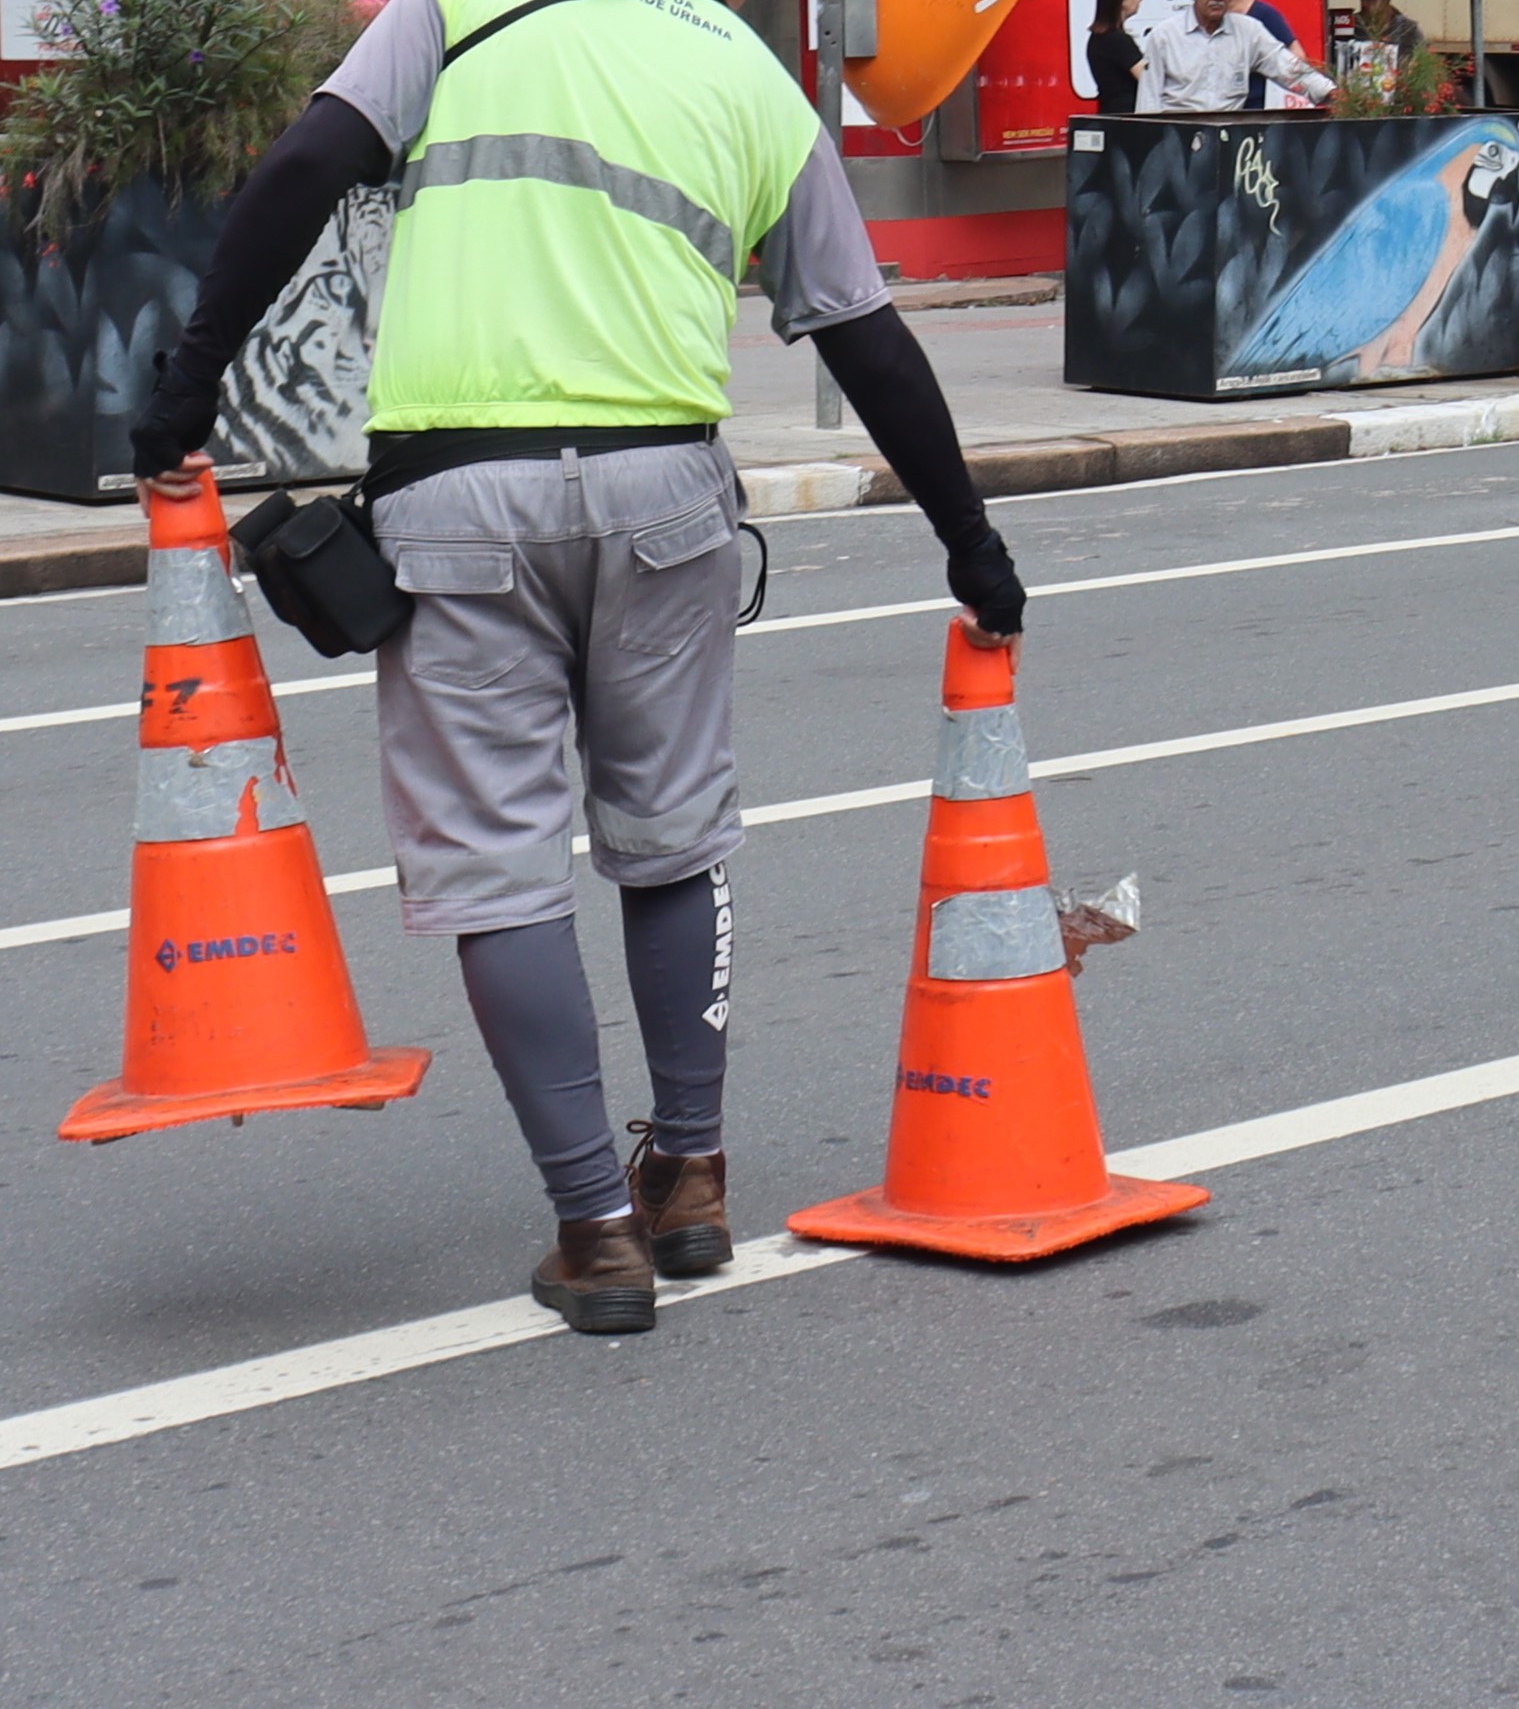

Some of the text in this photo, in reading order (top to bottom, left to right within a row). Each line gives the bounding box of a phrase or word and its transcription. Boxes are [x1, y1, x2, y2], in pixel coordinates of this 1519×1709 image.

[668, 4, 733, 42] URBANA
[708, 860, 734, 991] EMDEC
[187, 932, 298, 963] EMDEC
